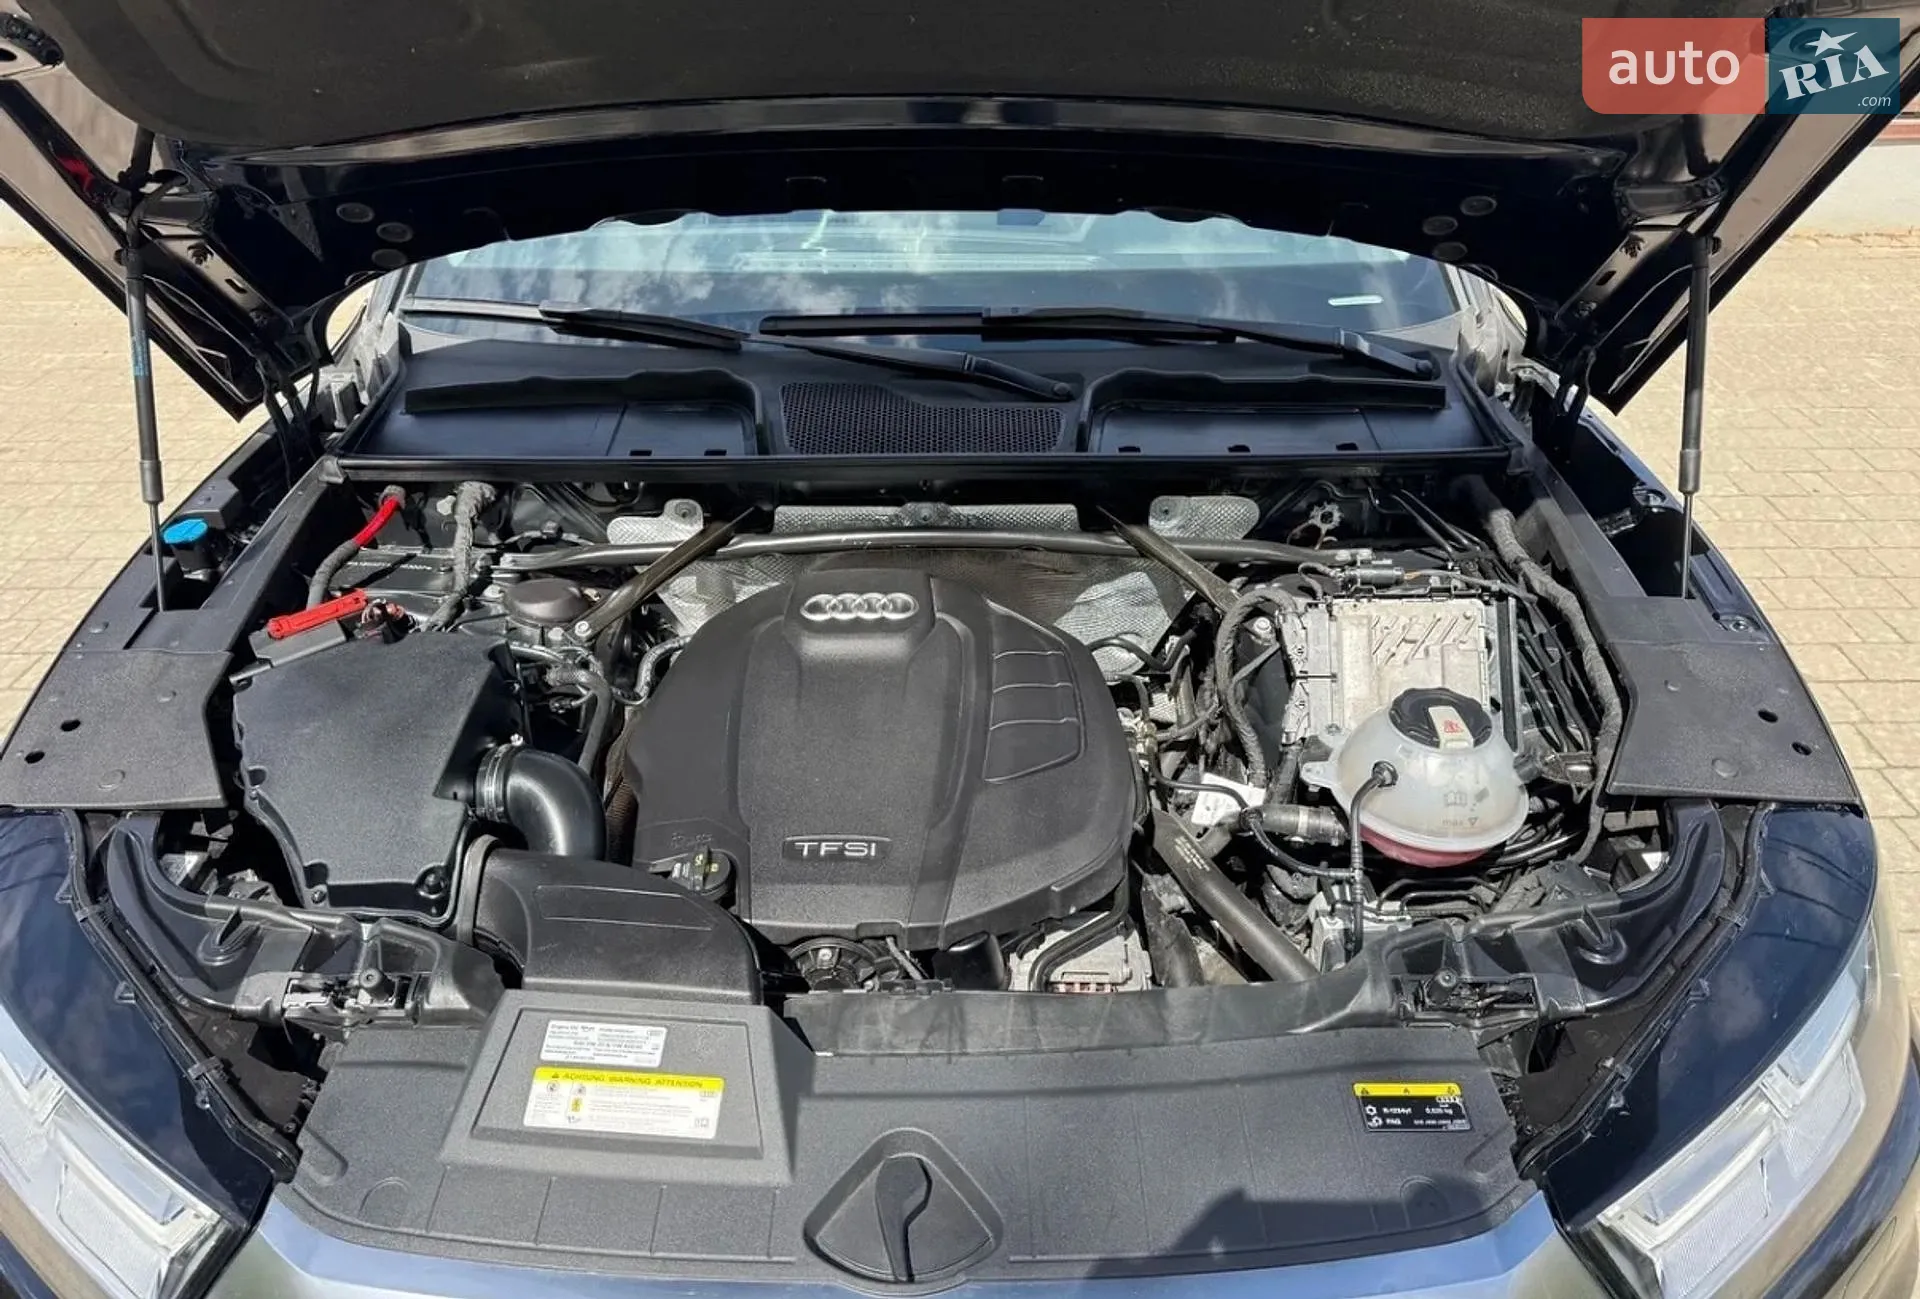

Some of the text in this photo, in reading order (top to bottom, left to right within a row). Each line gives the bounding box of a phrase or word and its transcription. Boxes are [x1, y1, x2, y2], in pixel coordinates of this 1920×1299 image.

[794, 842, 876, 857] TFSI
[607, 1076, 652, 1086] WARNING
[655, 1079, 703, 1088] ATTENTION
